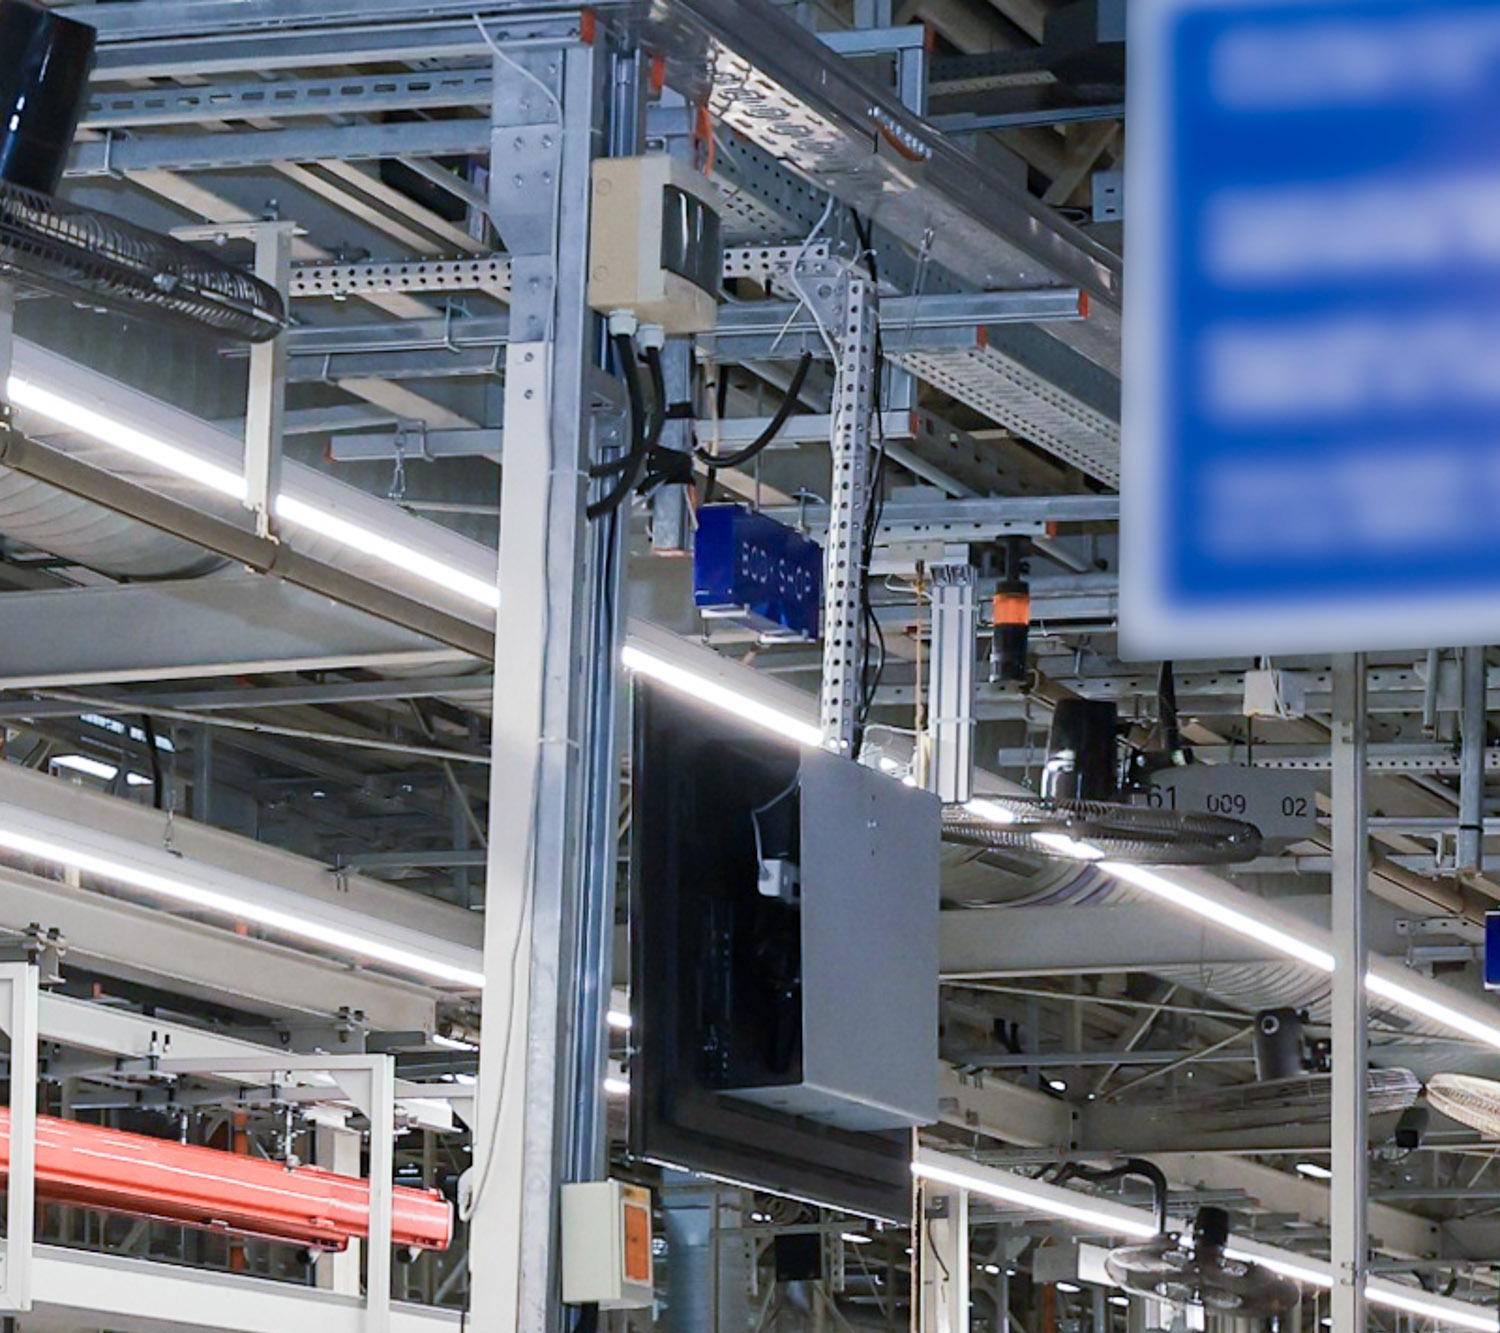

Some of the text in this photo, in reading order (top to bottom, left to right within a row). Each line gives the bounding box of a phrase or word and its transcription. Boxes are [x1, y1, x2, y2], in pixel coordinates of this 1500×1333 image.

[1147, 784, 1308, 817] 61 009 02
